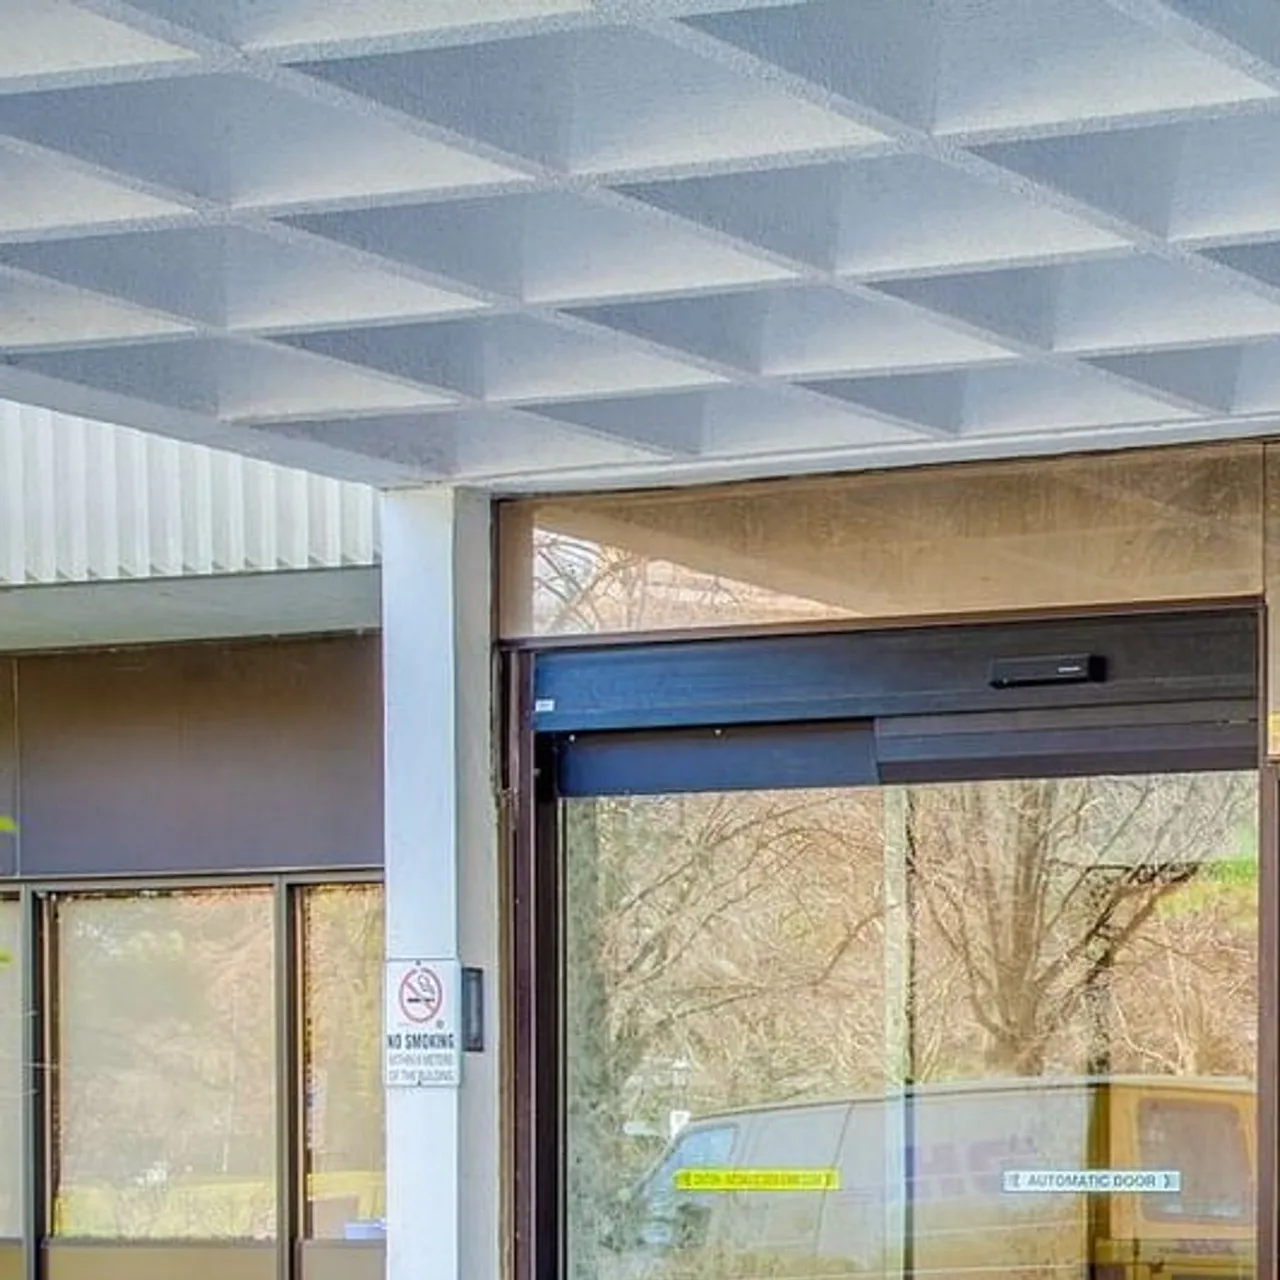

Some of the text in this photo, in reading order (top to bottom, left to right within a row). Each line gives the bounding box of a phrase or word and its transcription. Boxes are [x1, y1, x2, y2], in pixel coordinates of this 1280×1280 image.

[388, 1033, 454, 1049] NO SMOKING
[1028, 1174, 1155, 1187] AUTOMATIC DOOR
